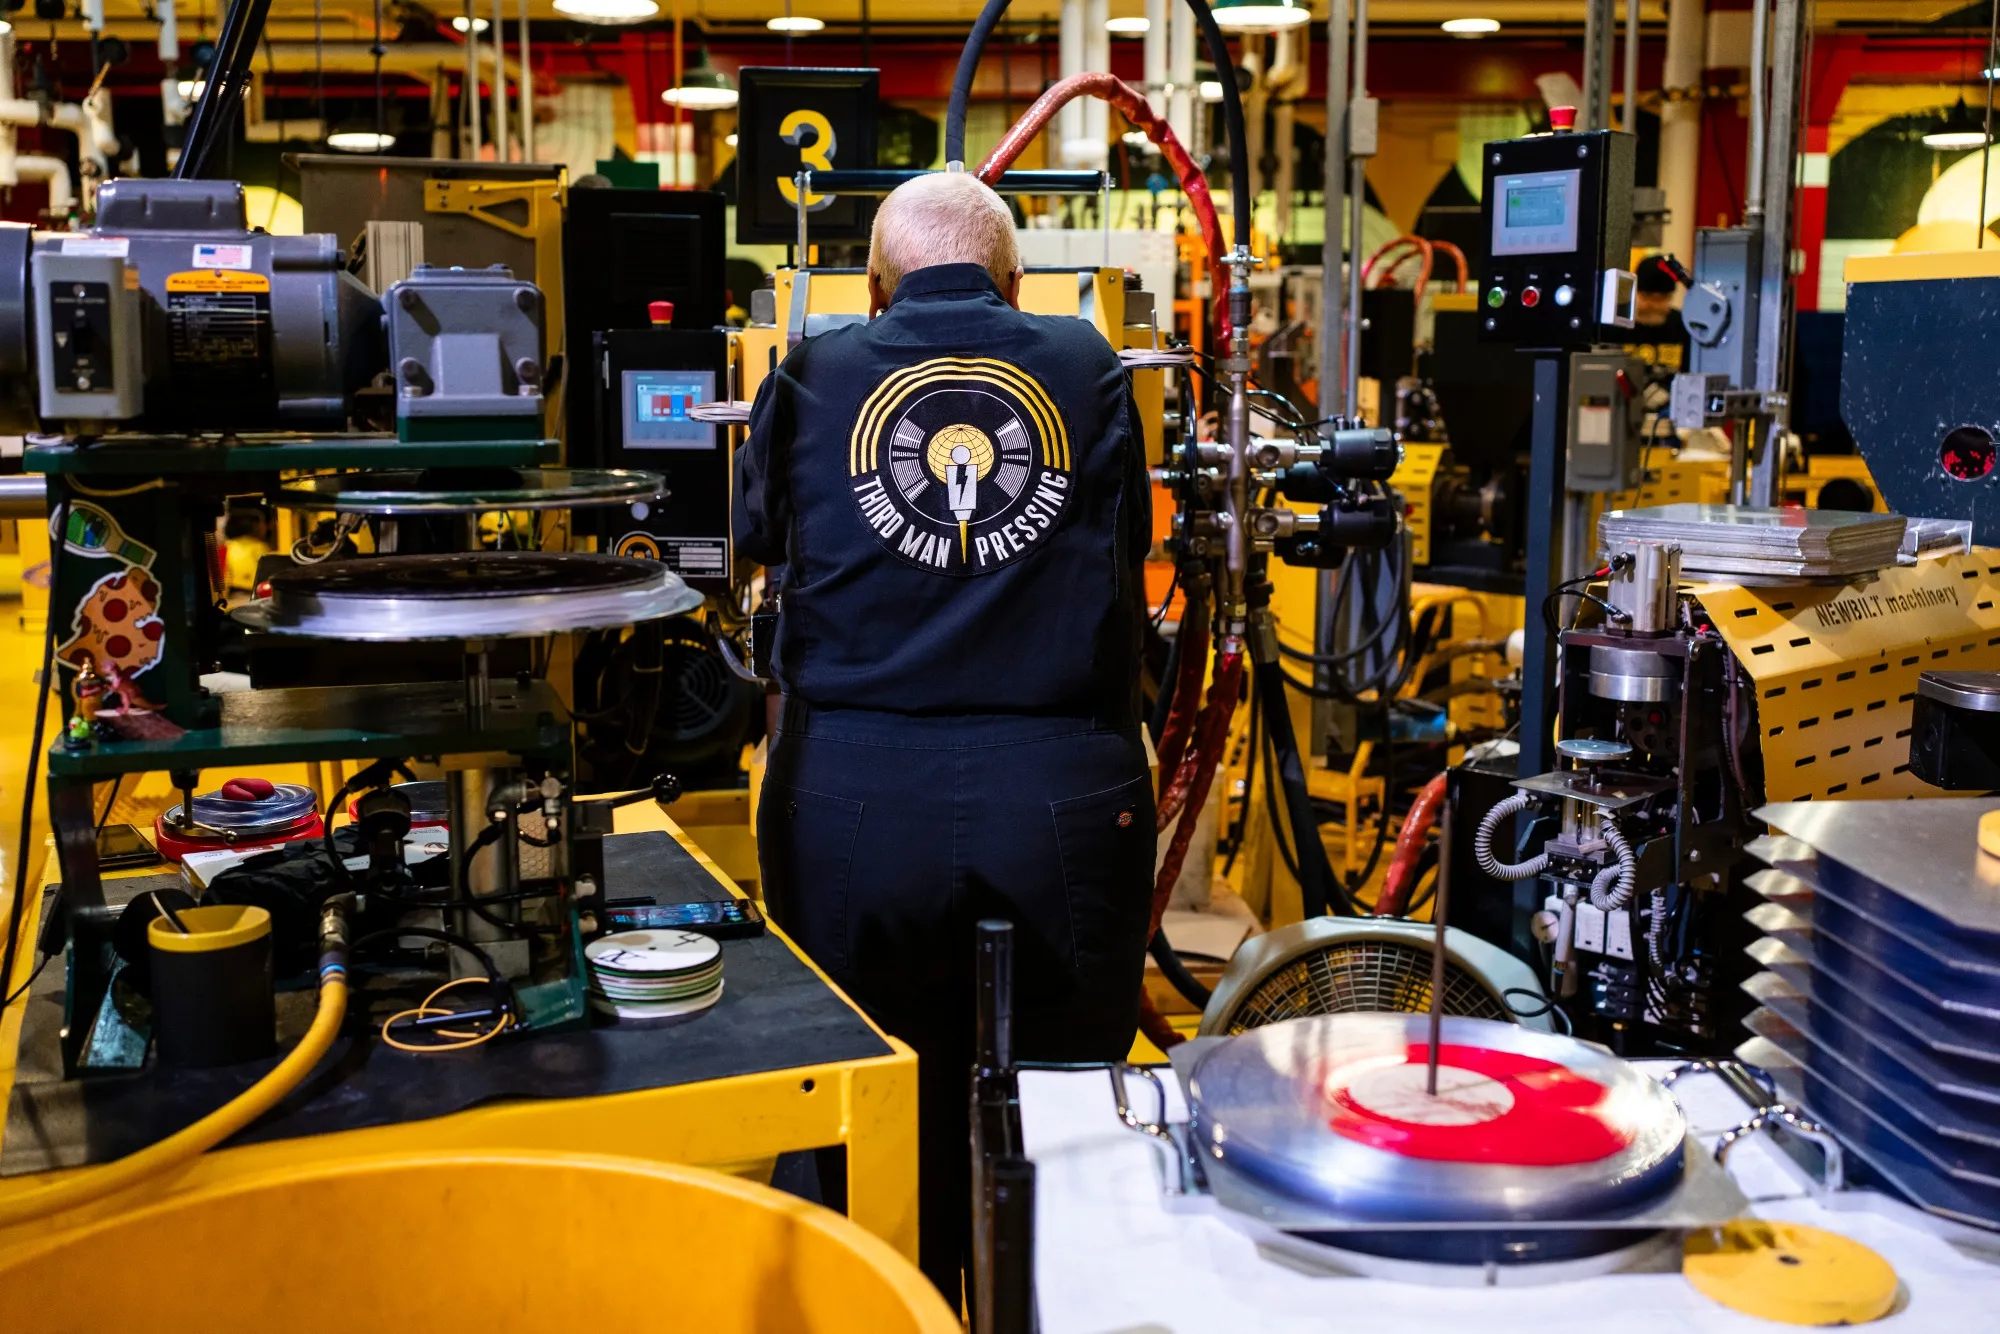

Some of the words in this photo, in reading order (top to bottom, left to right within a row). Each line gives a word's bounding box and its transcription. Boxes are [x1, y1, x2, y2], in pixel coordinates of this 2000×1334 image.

[777, 109, 837, 212] 3
[854, 476, 904, 539] THIRD
[898, 525, 951, 568] MAN
[975, 471, 1068, 566] PRESSING
[1815, 595, 1884, 627] NEWBILT
[1885, 586, 1959, 614] machinery
